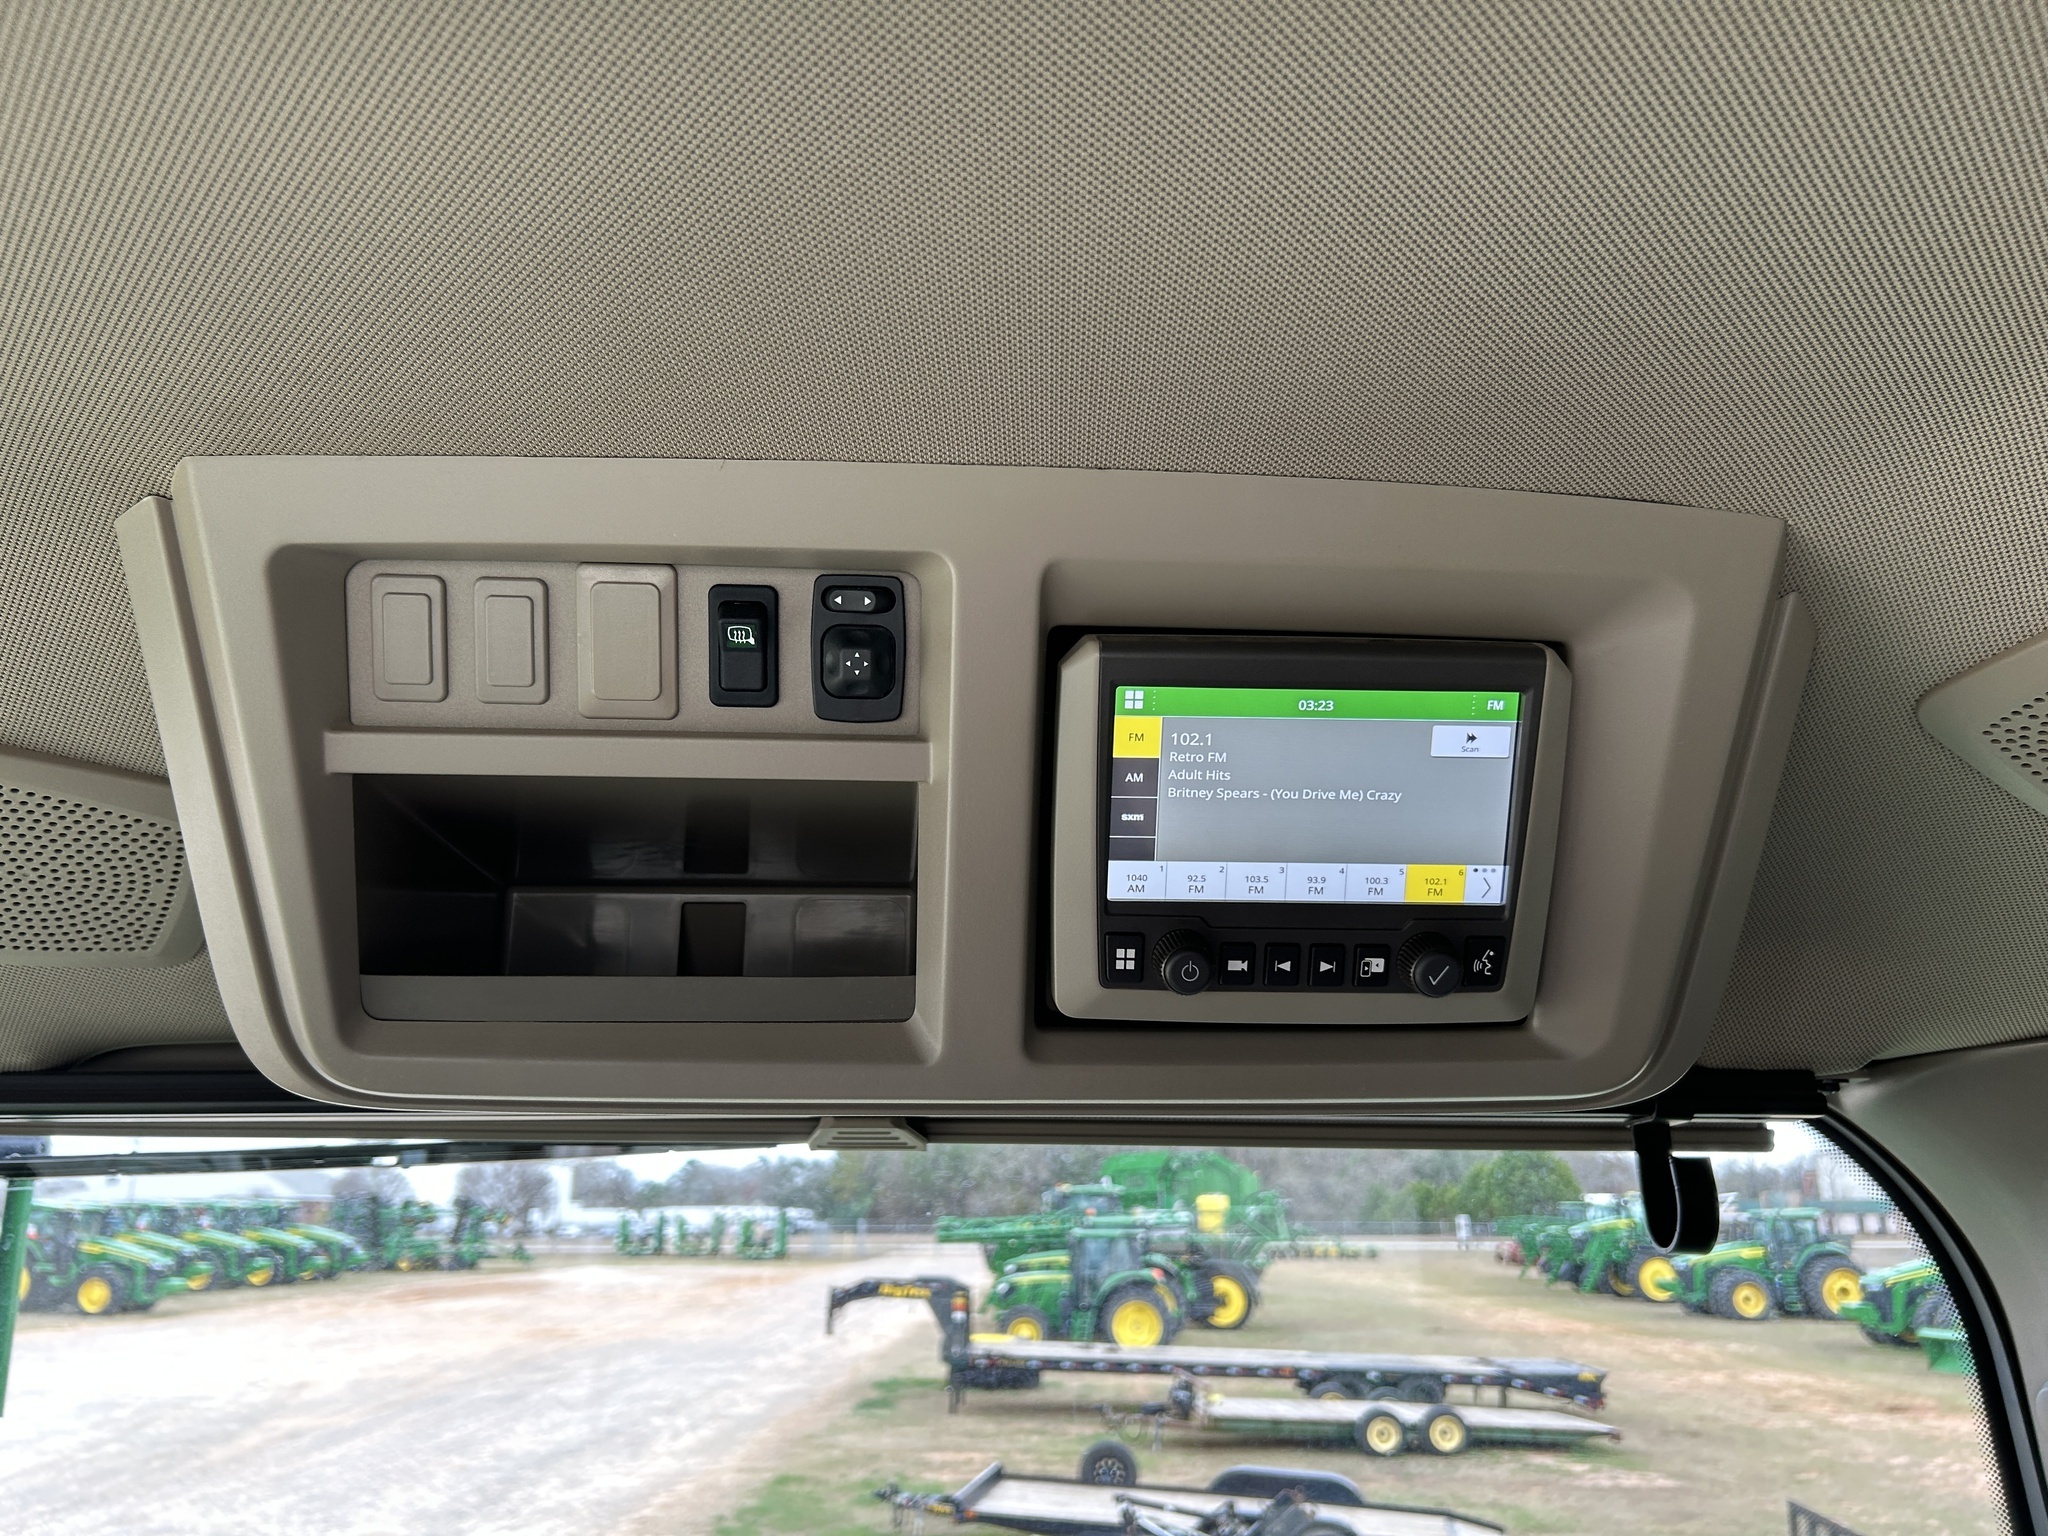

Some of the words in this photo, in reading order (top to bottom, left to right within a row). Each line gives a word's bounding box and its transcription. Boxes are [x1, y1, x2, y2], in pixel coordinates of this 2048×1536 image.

[1298, 699, 1334, 712] 03:23
[1486, 699, 1504, 711] FM
[1128, 732, 1144, 742] FM
[1171, 732, 1213, 746] 102.1
[1460, 745, 1479, 753] Scan
[1169, 751, 1204, 763] Retro
[1207, 752, 1227, 763] FM
[1124, 772, 1144, 783] AM
[1168, 769, 1202, 780] Adult
[1206, 769, 1231, 781] Hits
[1168, 787, 1213, 801] Britney
[1216, 787, 1260, 801] Spears
[1270, 788, 1299, 801] (You
[1302, 788, 1336, 800] Drive
[1339, 789, 1363, 802] Me)
[1366, 789, 1402, 803] Crazy
[1121, 813, 1144, 821] sxm
[1159, 865, 1164, 873] 1
[1278, 866, 1285, 874] 3
[1339, 867, 1345, 875] 4
[1399, 868, 1404, 876] 5
[1458, 869, 1464, 877] 6
[1126, 874, 1148, 882] 1040
[1187, 874, 1206, 883] 92.5
[1245, 875, 1269, 883] 103.5
[1307, 876, 1326, 884] 93.9
[1365, 877, 1389, 885] 100.3
[1424, 877, 1447, 885] 102.1
[1127, 884, 1145, 893] AM
[1188, 885, 1204, 894] FM
[1248, 885, 1264, 894] FM
[1308, 886, 1324, 895] FM
[1367, 887, 1384, 896] FM
[1427, 888, 1443, 896] FM
